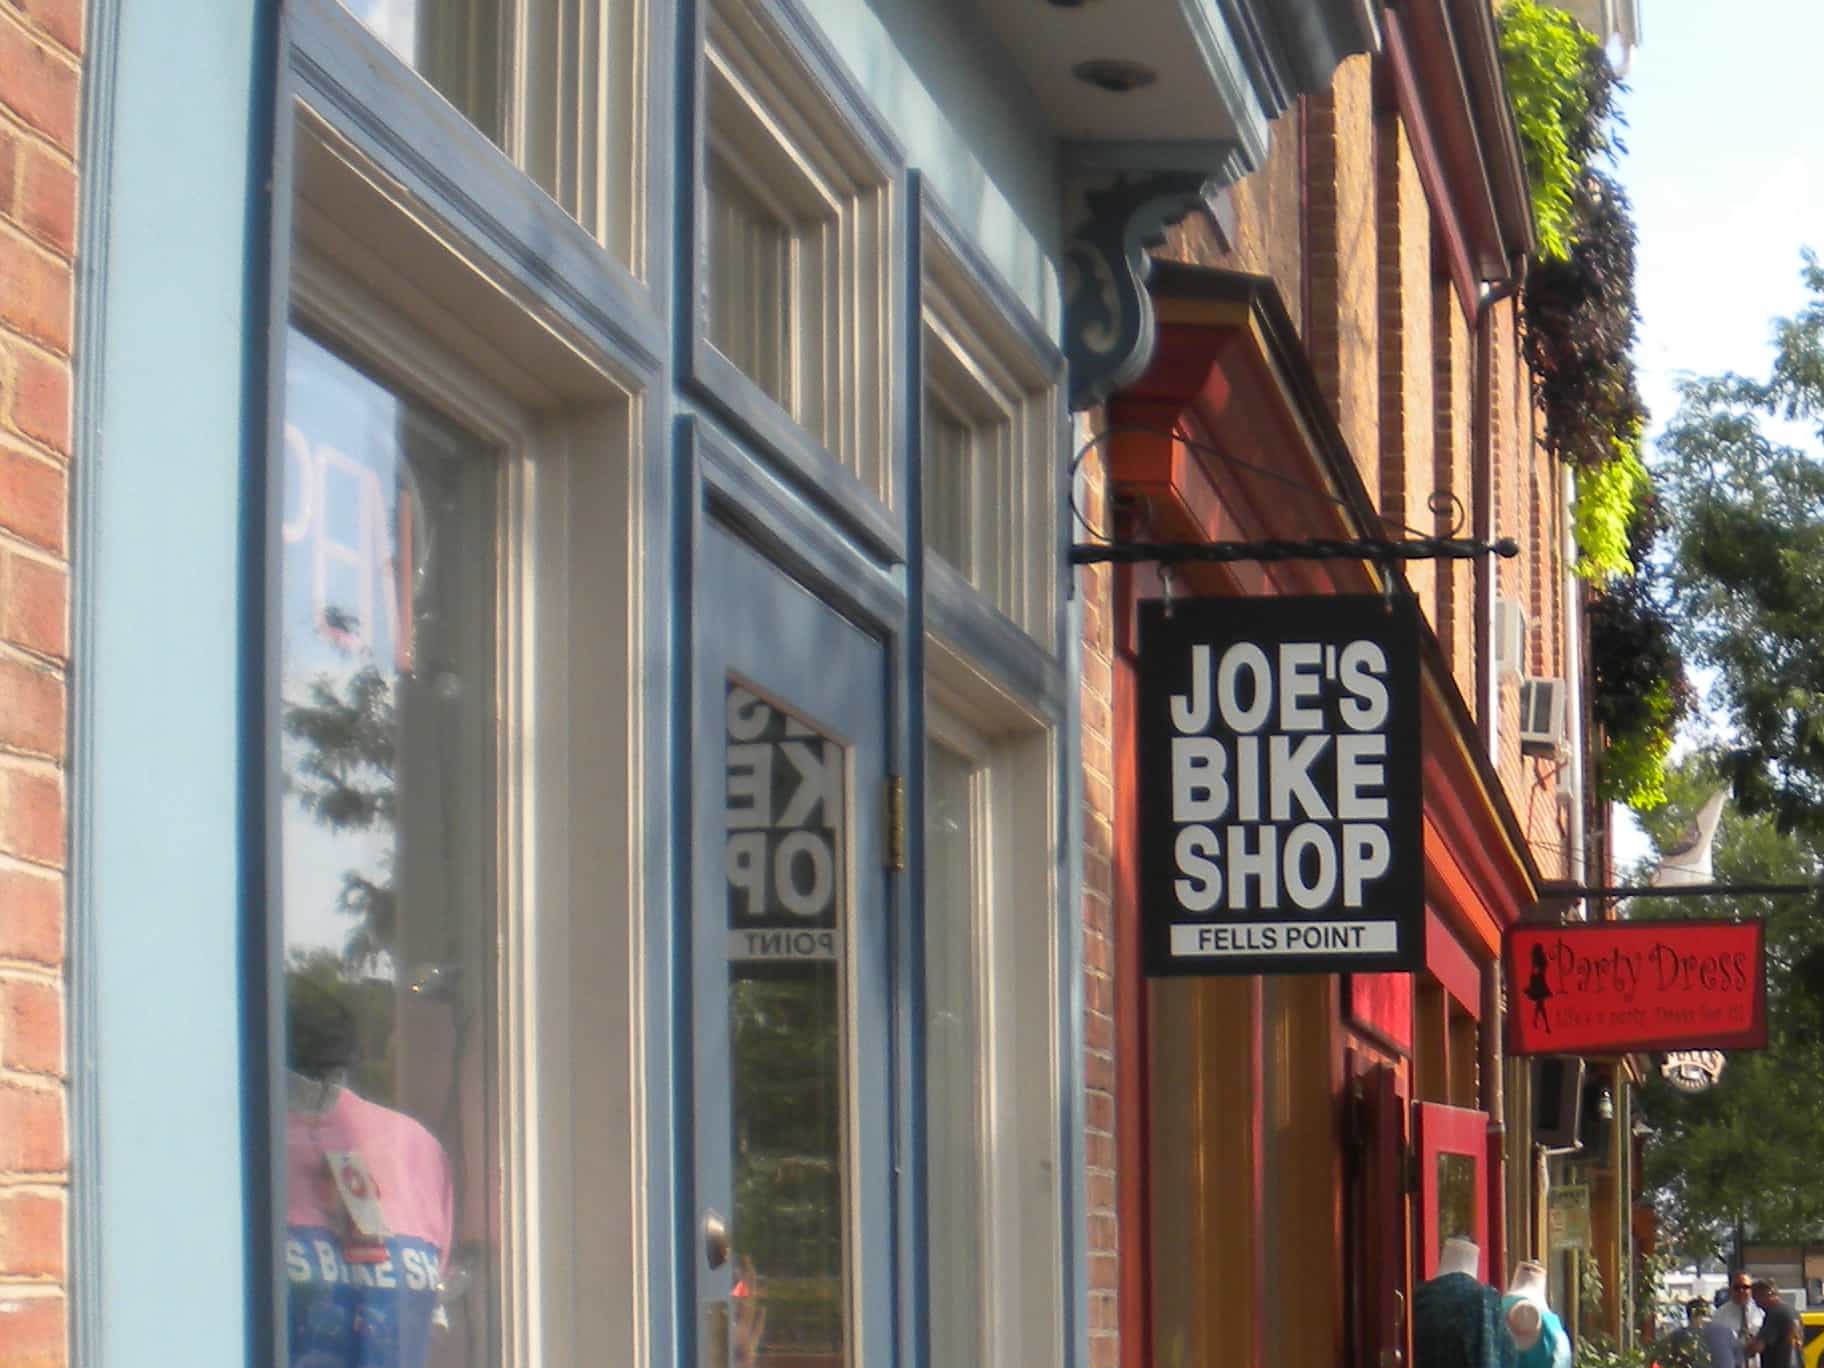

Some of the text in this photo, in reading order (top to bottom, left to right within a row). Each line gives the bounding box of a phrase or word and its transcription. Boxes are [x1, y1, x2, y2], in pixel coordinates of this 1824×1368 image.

[1169, 639, 1390, 734] JOE'S
[1170, 733, 1389, 823] BIKE
[1173, 822, 1391, 911] SHOP
[1198, 925, 1366, 951] FELLS POINT
[1547, 936, 1747, 1003] Party Dress
